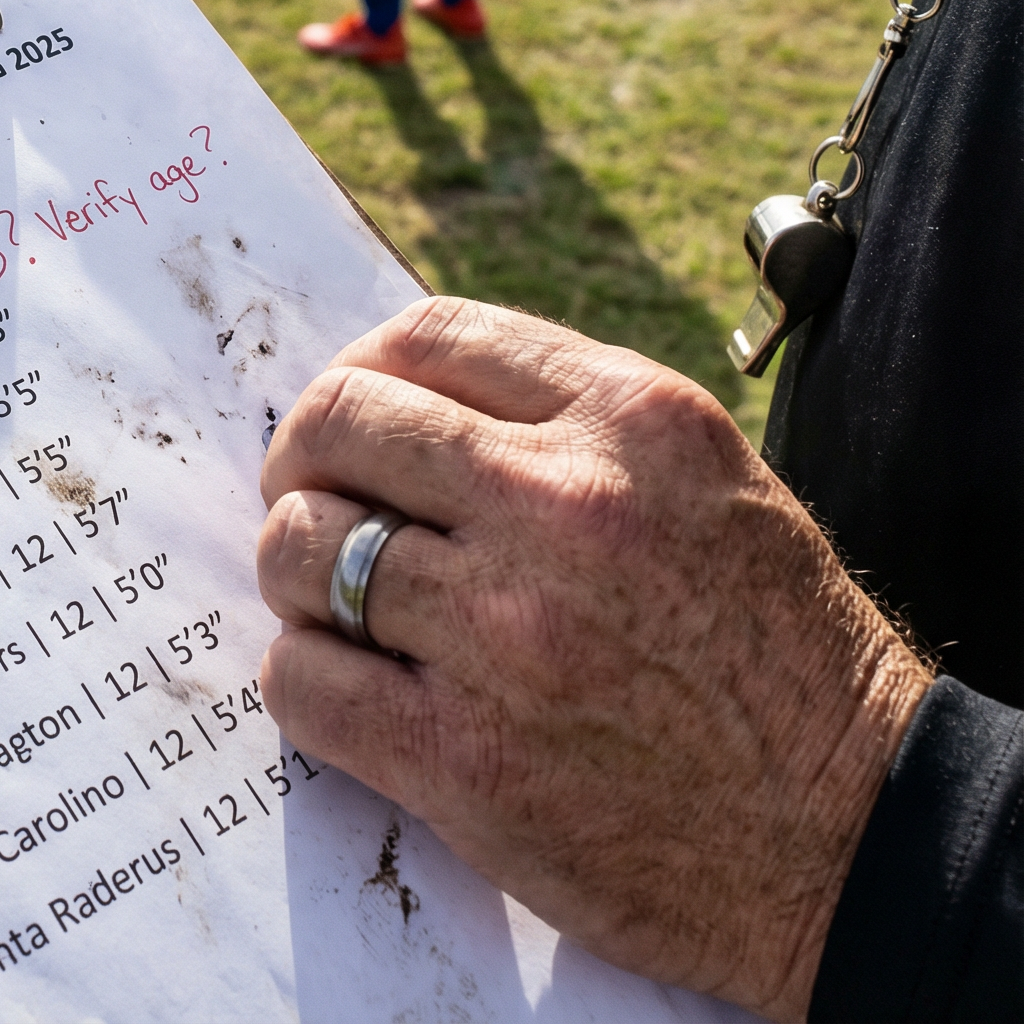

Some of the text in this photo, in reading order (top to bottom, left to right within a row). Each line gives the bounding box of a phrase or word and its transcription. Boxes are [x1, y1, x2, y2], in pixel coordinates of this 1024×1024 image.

[5, 27, 74, 71] 2025
[34, 179, 149, 241] Verify
[149, 125, 228, 204] age?
[16, 434, 71, 484] 5'5"
[11, 534, 55, 573] 12
[73, 487, 128, 539] 5'7"
[50, 600, 95, 640] 12
[113, 552, 168, 605] 5'0"
[104, 662, 149, 702] 12
[167, 610, 221, 665] 5'3"
[149, 729, 194, 771] 12
[47, 839, 181, 933] Raderus
[203, 793, 248, 837] 12
